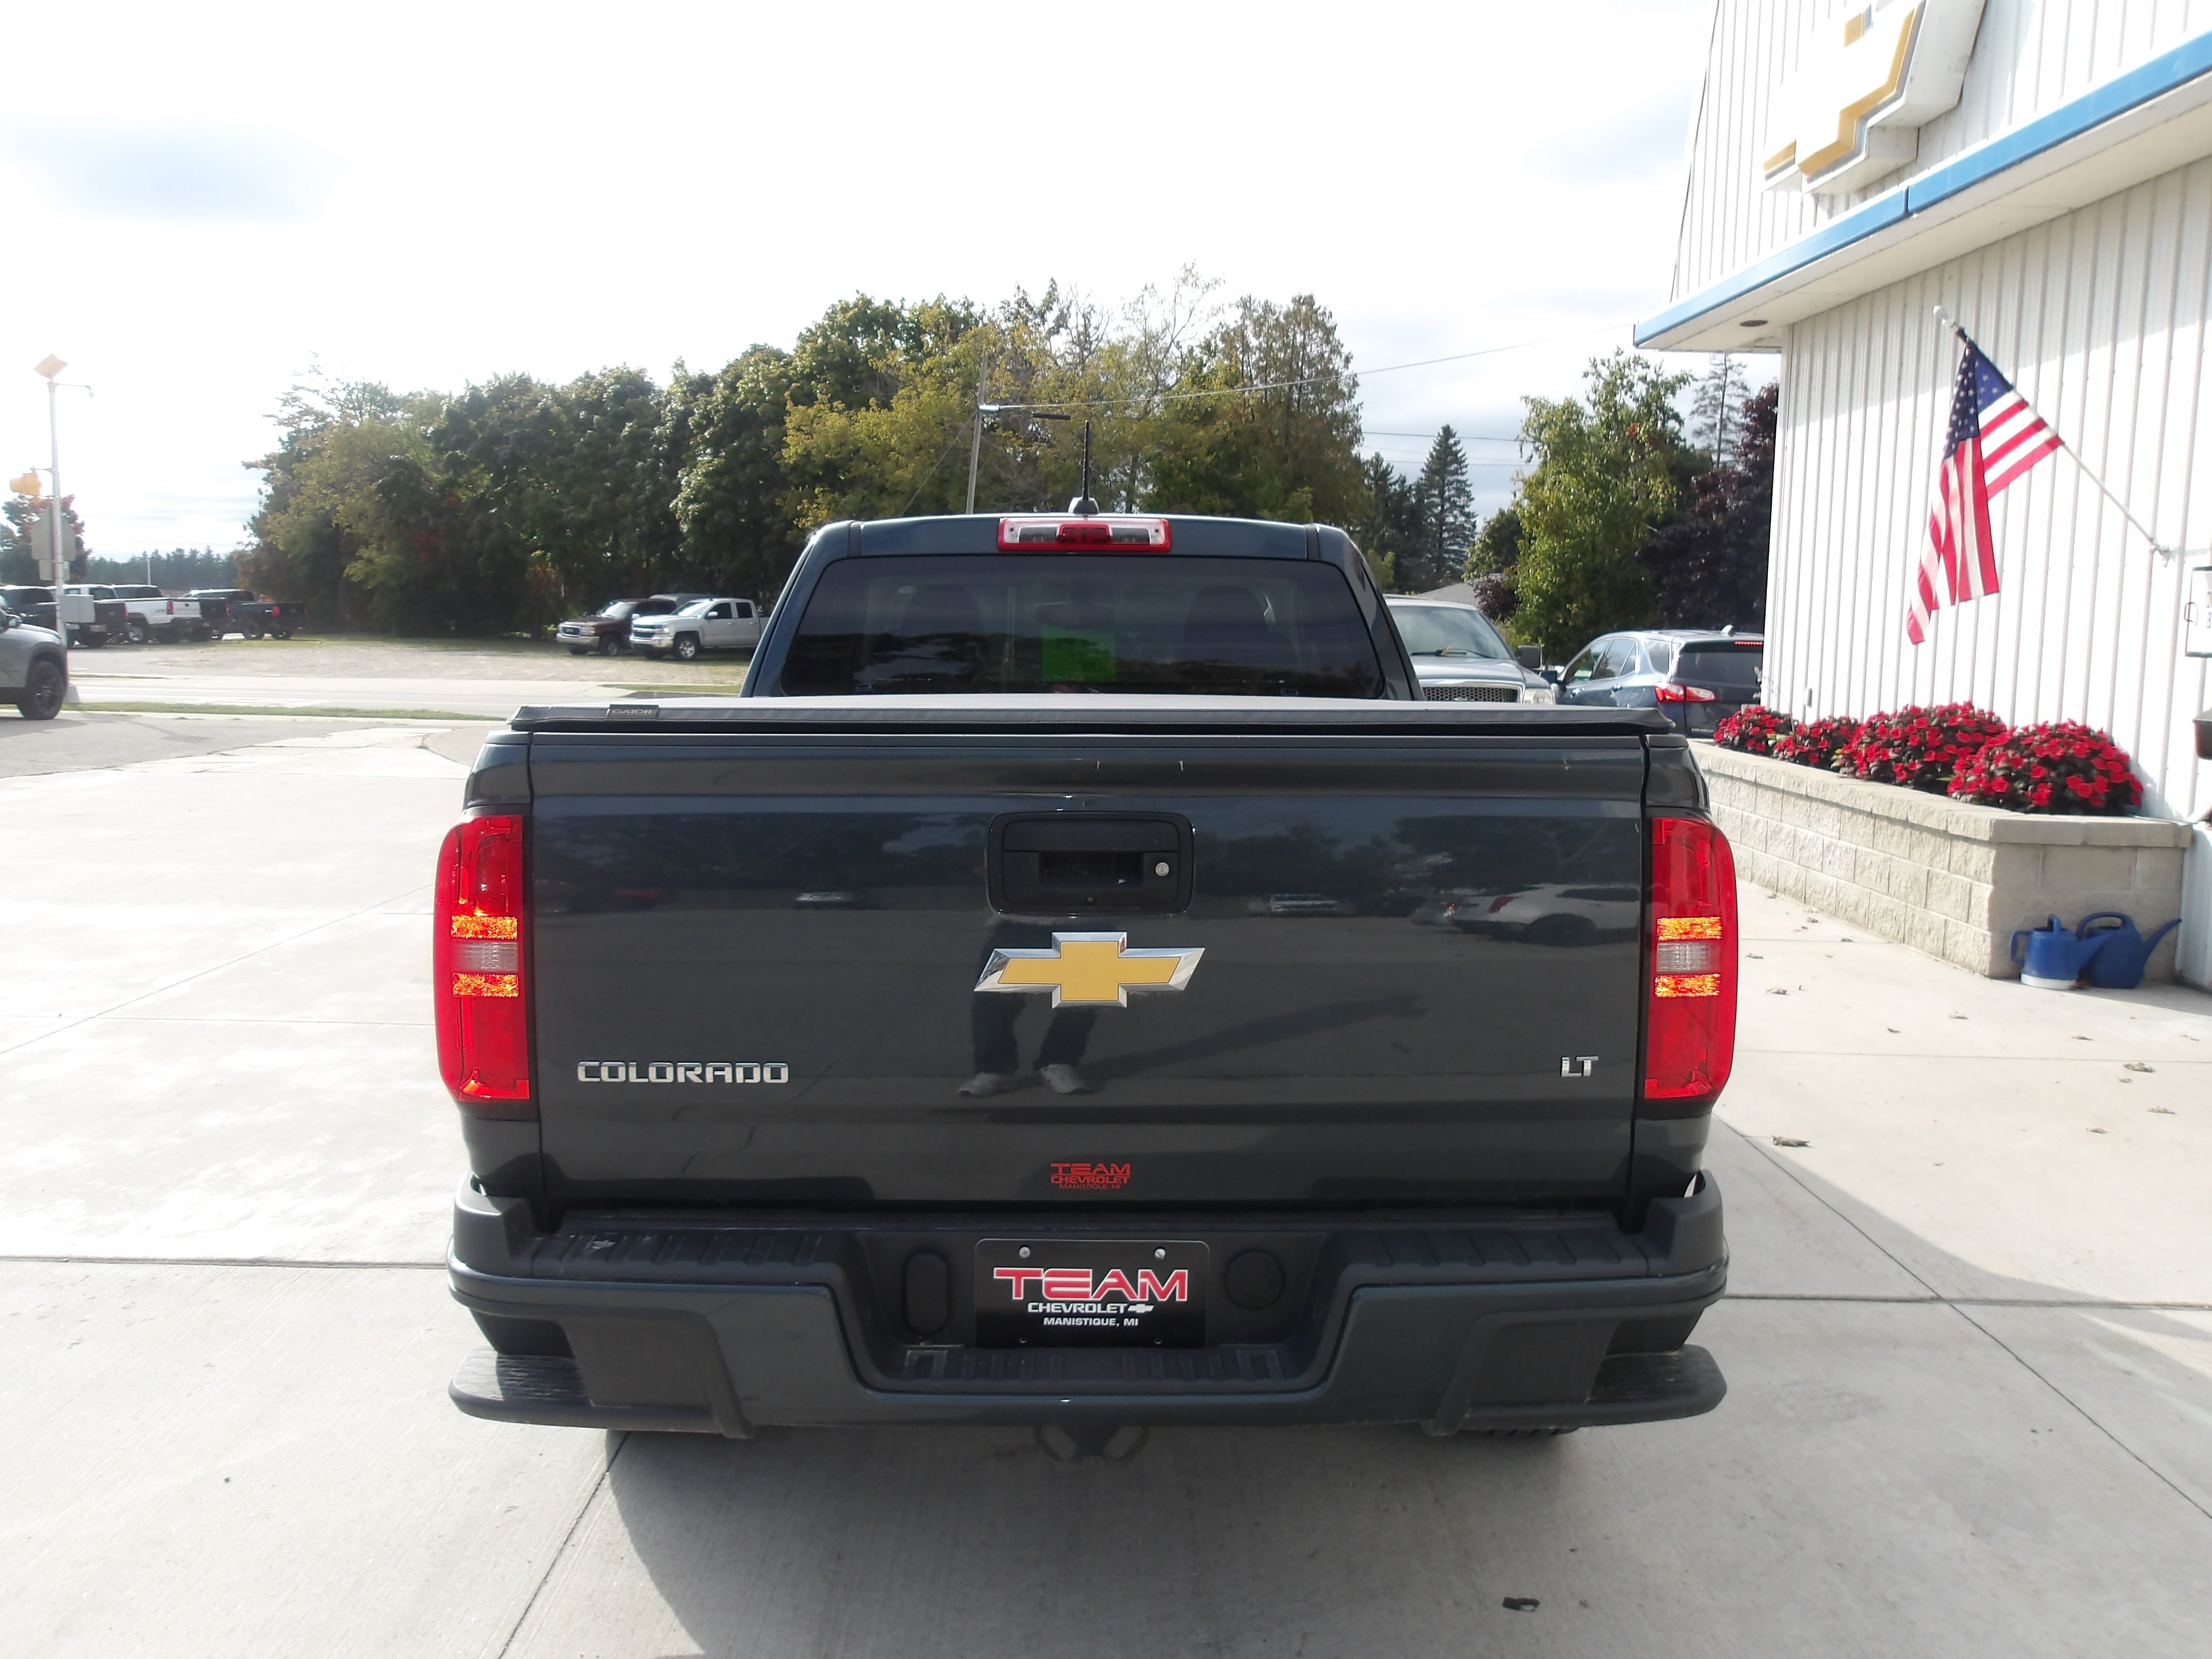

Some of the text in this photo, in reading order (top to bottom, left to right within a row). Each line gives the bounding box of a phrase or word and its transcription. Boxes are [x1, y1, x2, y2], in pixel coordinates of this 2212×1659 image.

[577, 1061, 789, 1083] COLORADO
[1561, 1056, 1599, 1077] LT
[1050, 1163, 1131, 1176] TEAM
[993, 1267, 1188, 1301] TEAM
[1028, 1302, 1127, 1313] CHEVROLET
[1043, 1317, 1138, 1327] MANISTIQUE, MI
